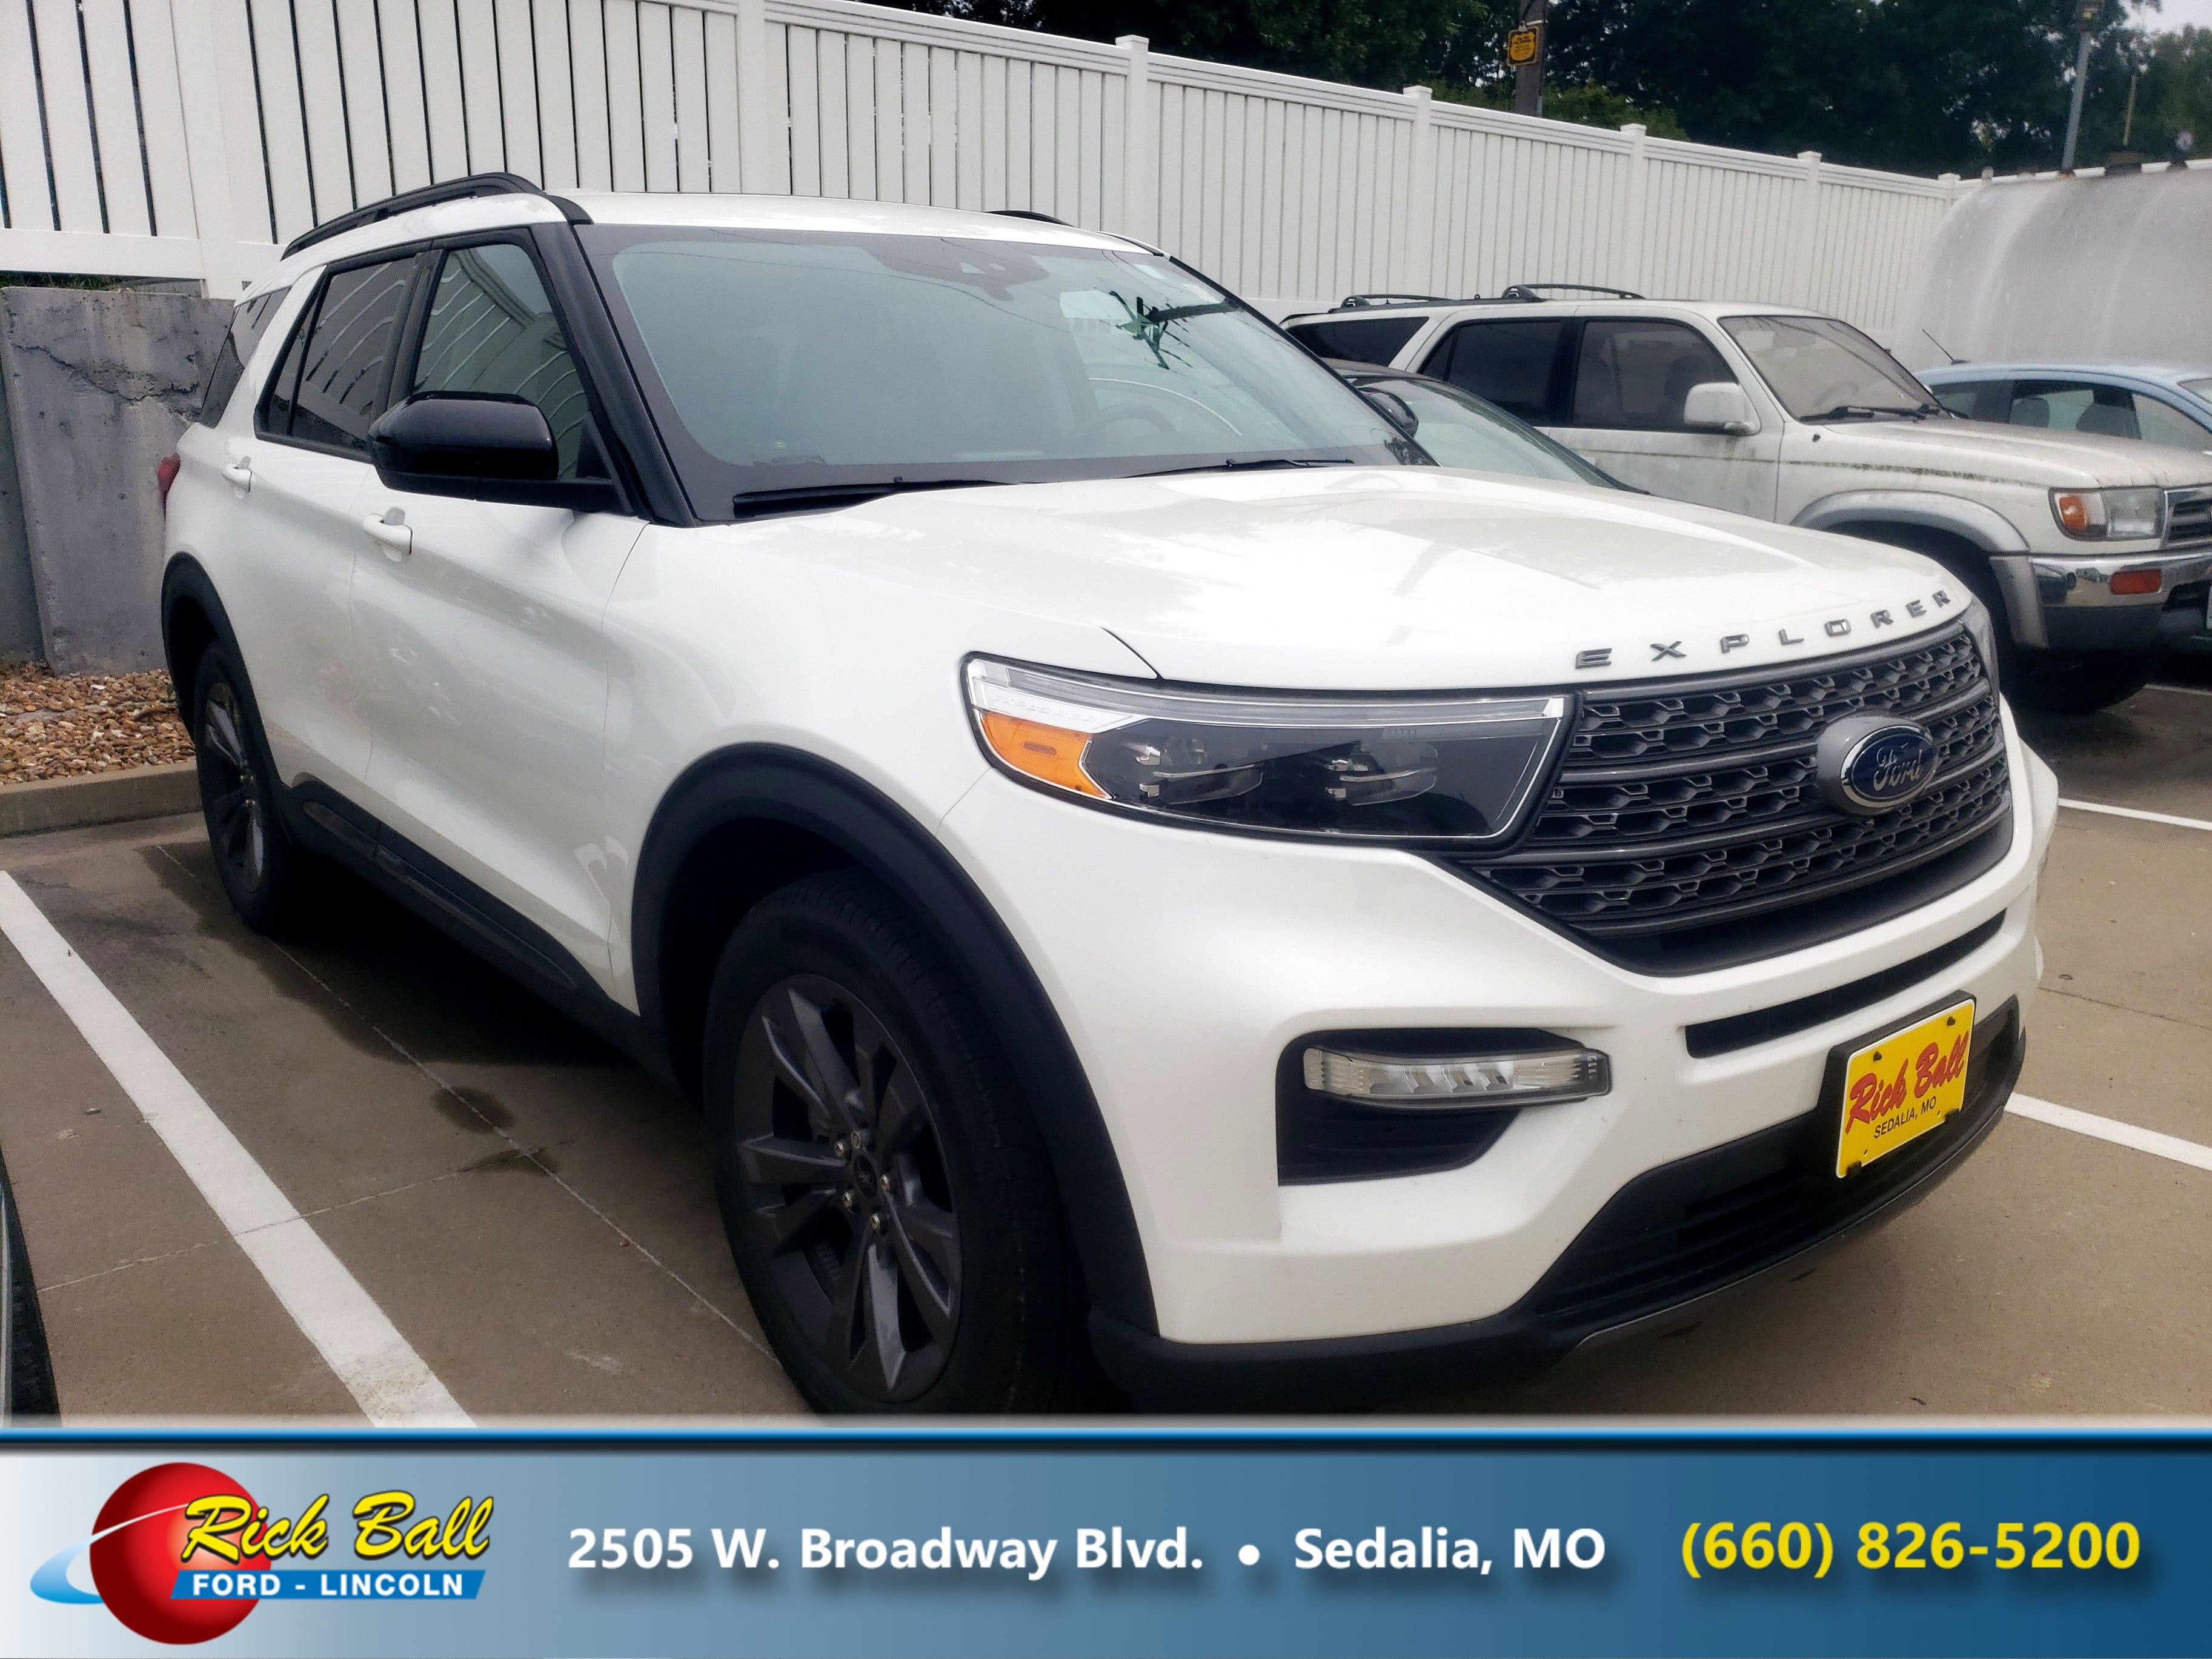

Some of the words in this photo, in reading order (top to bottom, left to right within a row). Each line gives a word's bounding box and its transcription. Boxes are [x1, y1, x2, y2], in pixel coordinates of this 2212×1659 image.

[1575, 590, 1951, 668] EXPLORER
[1873, 742, 1923, 791] Ford
[1845, 1058, 1908, 1134] Rick
[1914, 1030, 1969, 1099] Ball
[1874, 1108, 1918, 1139] SEDALIA,
[1921, 1095, 1936, 1115] MO
